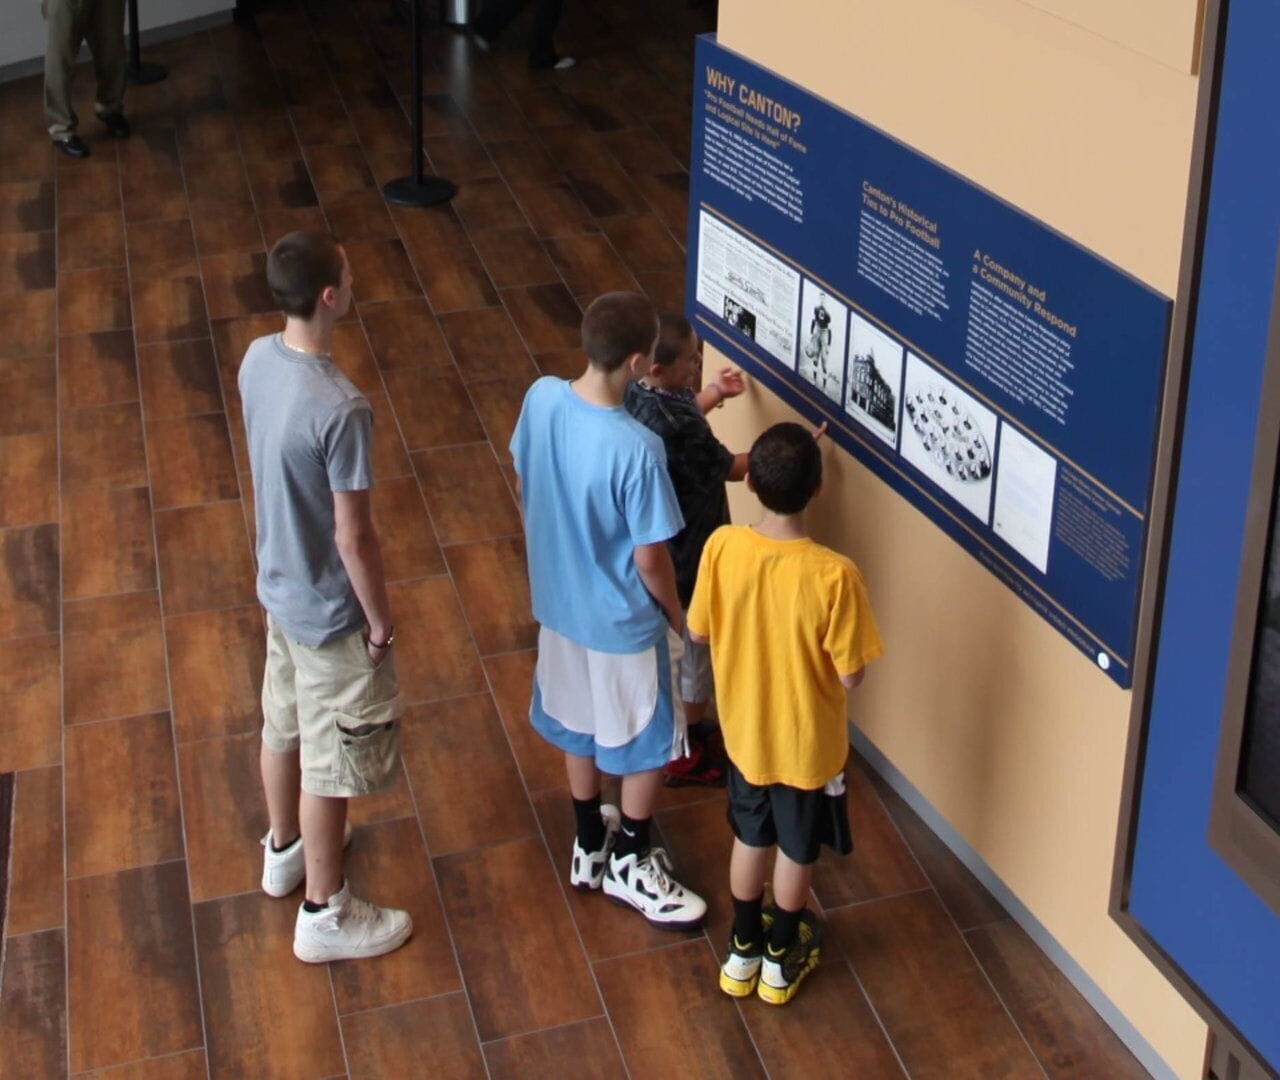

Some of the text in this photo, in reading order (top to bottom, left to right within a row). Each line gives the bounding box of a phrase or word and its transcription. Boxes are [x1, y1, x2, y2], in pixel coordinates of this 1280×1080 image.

[706, 65, 802, 134] WHY CANTON?
[904, 220, 941, 250] Football
[980, 266, 1033, 310] Community
[1033, 301, 1078, 338] Respond
[983, 254, 1026, 291] Company
[1027, 283, 1047, 303] and
